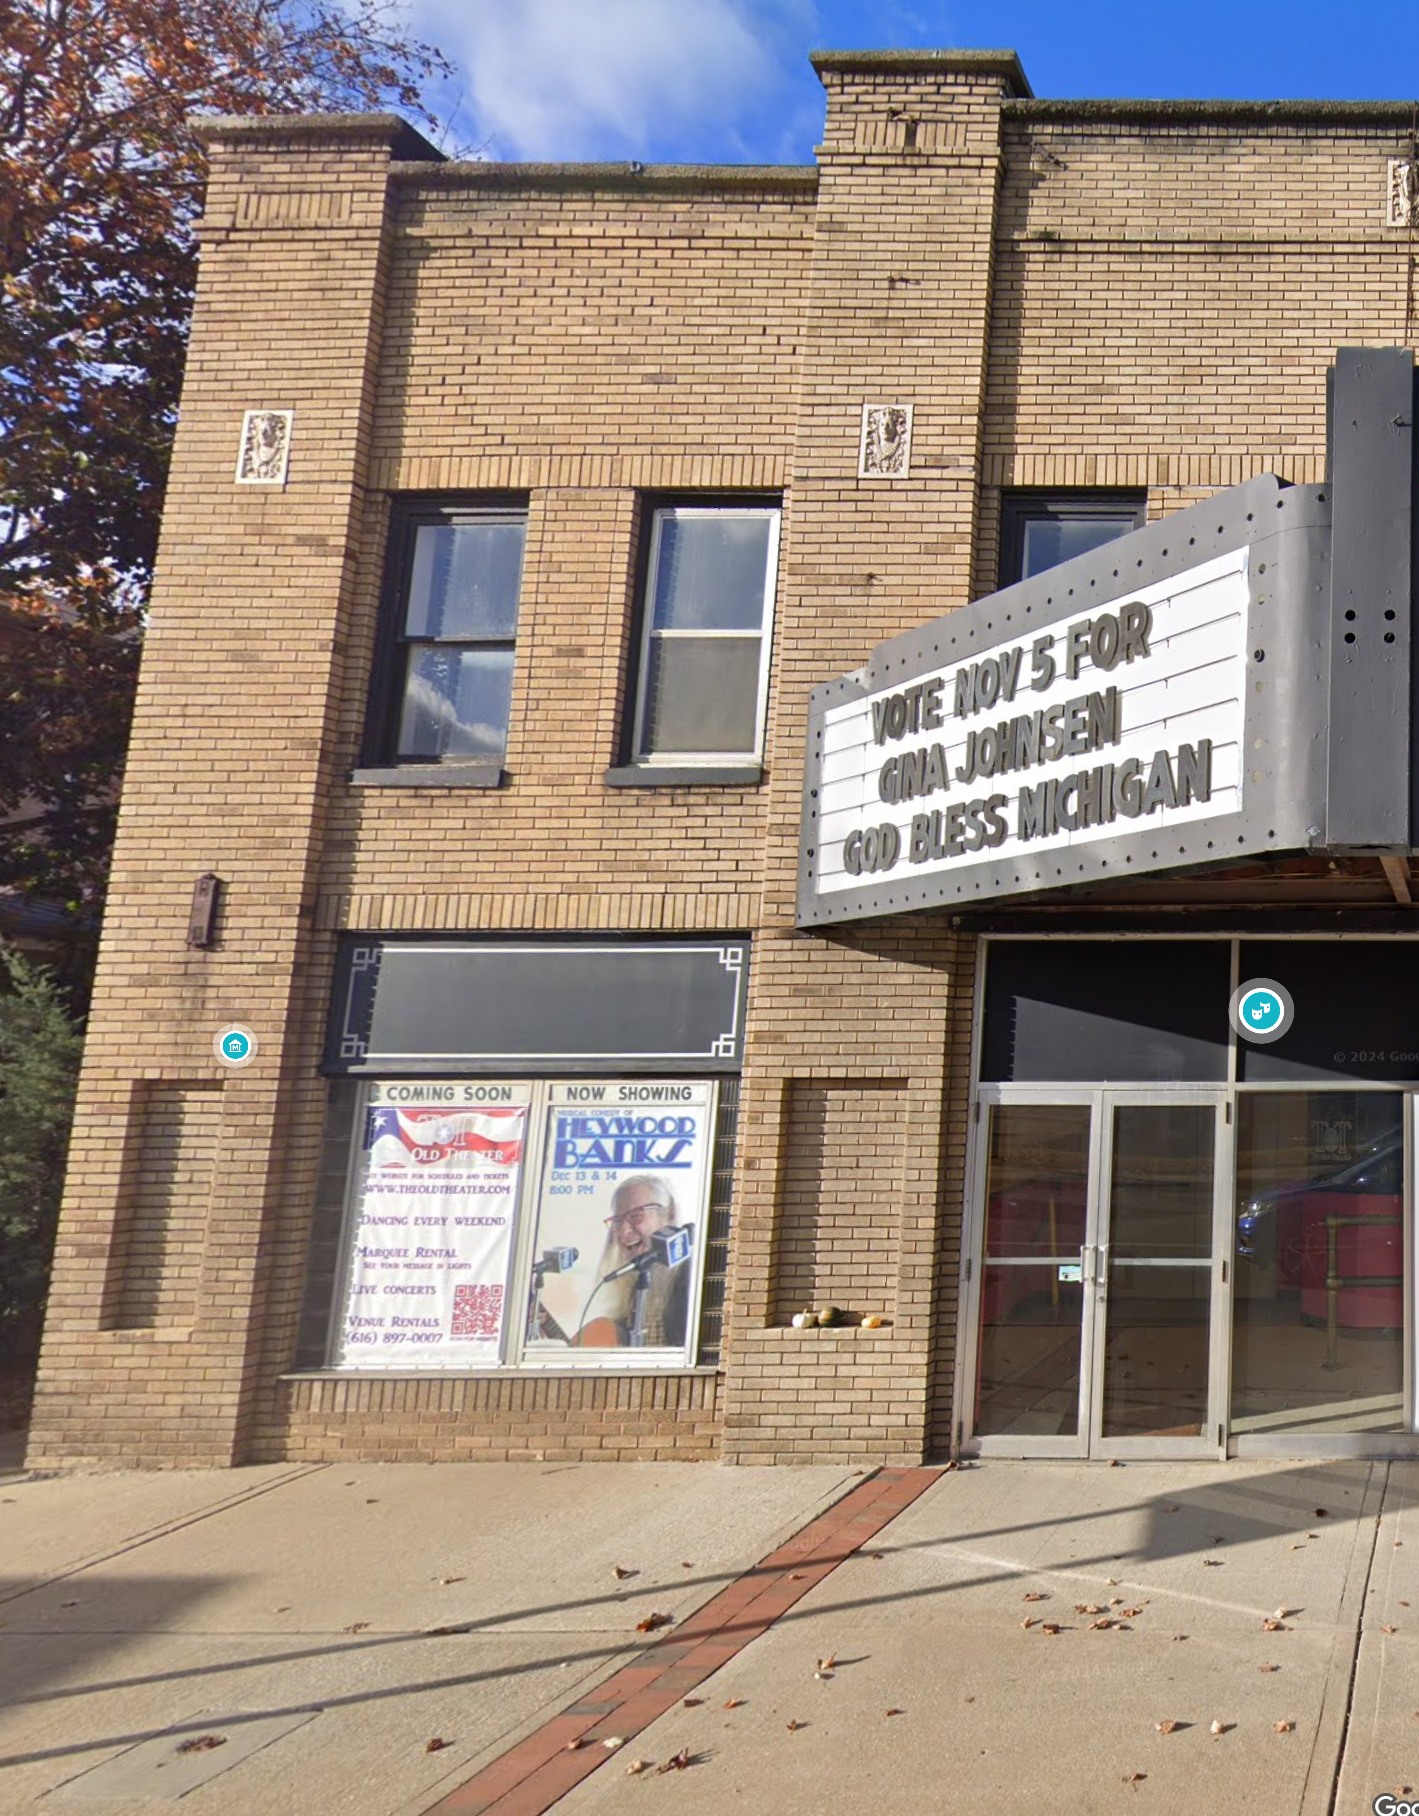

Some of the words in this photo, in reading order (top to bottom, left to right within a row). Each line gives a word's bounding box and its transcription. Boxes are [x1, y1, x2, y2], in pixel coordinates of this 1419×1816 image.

[871, 676, 944, 745] VOTE
[953, 646, 1024, 719] NOV
[1031, 634, 1056, 691] 5
[1066, 601, 1153, 680] FOR
[878, 743, 950, 805] GINA
[955, 686, 1121, 784] JOHNSEN
[843, 823, 901, 876] GOD
[909, 794, 1009, 864] BLESS
[1017, 738, 1213, 841] MICHIGAN
[386, 1086, 455, 1101] COMING
[464, 1085, 512, 1101] SOON
[566, 1086, 606, 1101] NOW
[619, 1086, 693, 1101] SHOWING
[556, 1116, 696, 1139] HEYWOOD
[575, 1171, 586, 1181] 13
[591, 1171, 600, 1181] &
[605, 1171, 617, 1180] 14
[366, 1185, 511, 1195] WWW.THEOLDTHEATER.COM
[549, 1185, 572, 1195] 8:00
[577, 1185, 595, 1194] PM
[414, 1216, 449, 1226] EVERY
[455, 1216, 506, 1226] WEEKEND
[383, 1285, 437, 1295] CONCERTS
[346, 1332, 378, 1345] (616)
[382, 1332, 443, 1344] 897-0007
